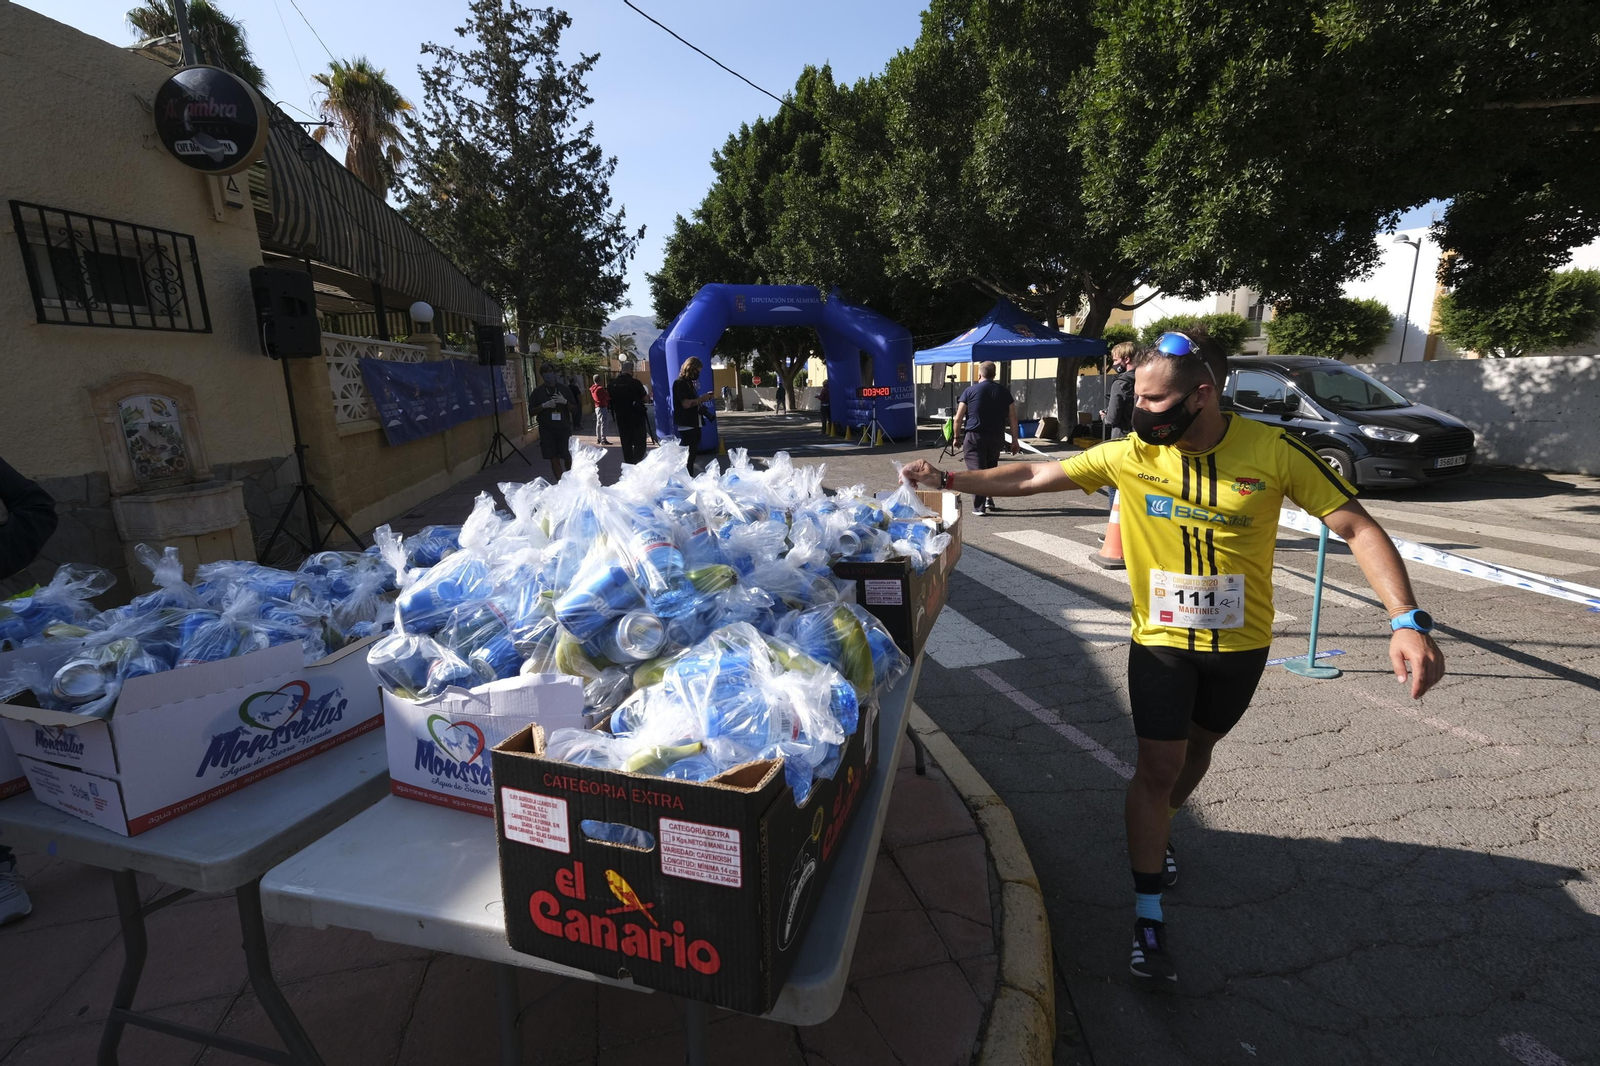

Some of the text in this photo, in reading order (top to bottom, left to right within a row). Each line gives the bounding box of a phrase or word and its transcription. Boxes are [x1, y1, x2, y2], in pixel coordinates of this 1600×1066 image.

[1174, 505, 1228, 526] BSA
[1172, 577, 1200, 586] CIRCUITO
[1201, 579, 1219, 587] 2020
[1174, 590, 1216, 607] 111
[1178, 606, 1219, 615] MARTINIES
[196, 698, 349, 778] Monssalus
[220, 728, 333, 779] Agua de Sierra Nevada
[415, 738, 493, 788] Monssa
[148, 718, 380, 825] agua mineral natural agua mineral natural agua mineral natural
[3, 780, 27, 794] agua
[431, 777, 454, 790] Agua
[454, 782, 463, 791] de
[464, 784, 488, 796] Sierra
[543, 773, 684, 811] CATEGORIA EXTRA
[396, 785, 410, 795] agua
[409, 787, 429, 800] mineral
[429, 793, 449, 804] natural
[451, 798, 467, 809] agua
[466, 801, 489, 813] mineral
[668, 822, 731, 840] CATEGORÍA EXTRA
[663, 845, 733, 864] VARIEDAD: CAVENDISH
[708, 842, 738, 853] MANILLAS
[663, 856, 697, 868] LONGITUD:
[697, 862, 720, 873] MÍNIMA
[555, 860, 586, 901] el
[529, 890, 721, 976] Canario
